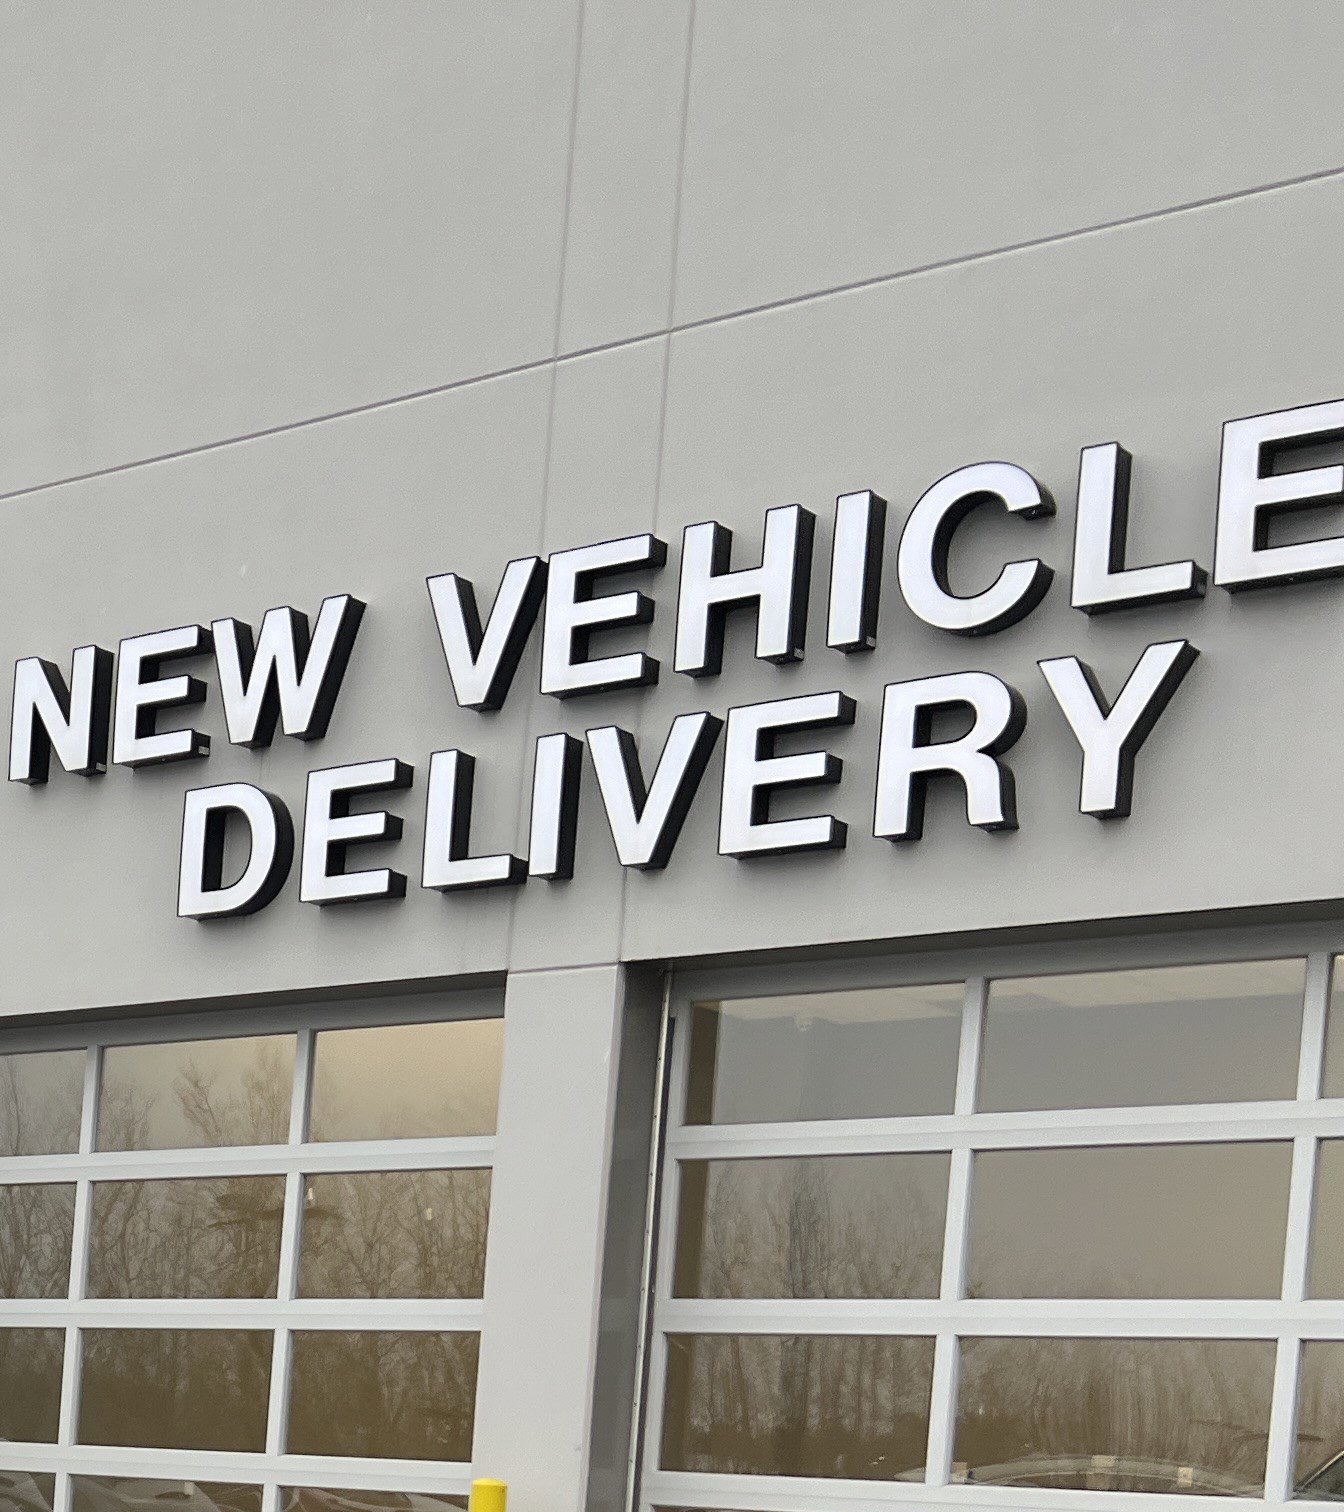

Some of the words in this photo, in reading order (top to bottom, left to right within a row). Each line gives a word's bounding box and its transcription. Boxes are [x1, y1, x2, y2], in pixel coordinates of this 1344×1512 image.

[9, 594, 366, 784] NEW
[425, 398, 1344, 711] VEHICLE
[176, 639, 1199, 920] DELIVERY
